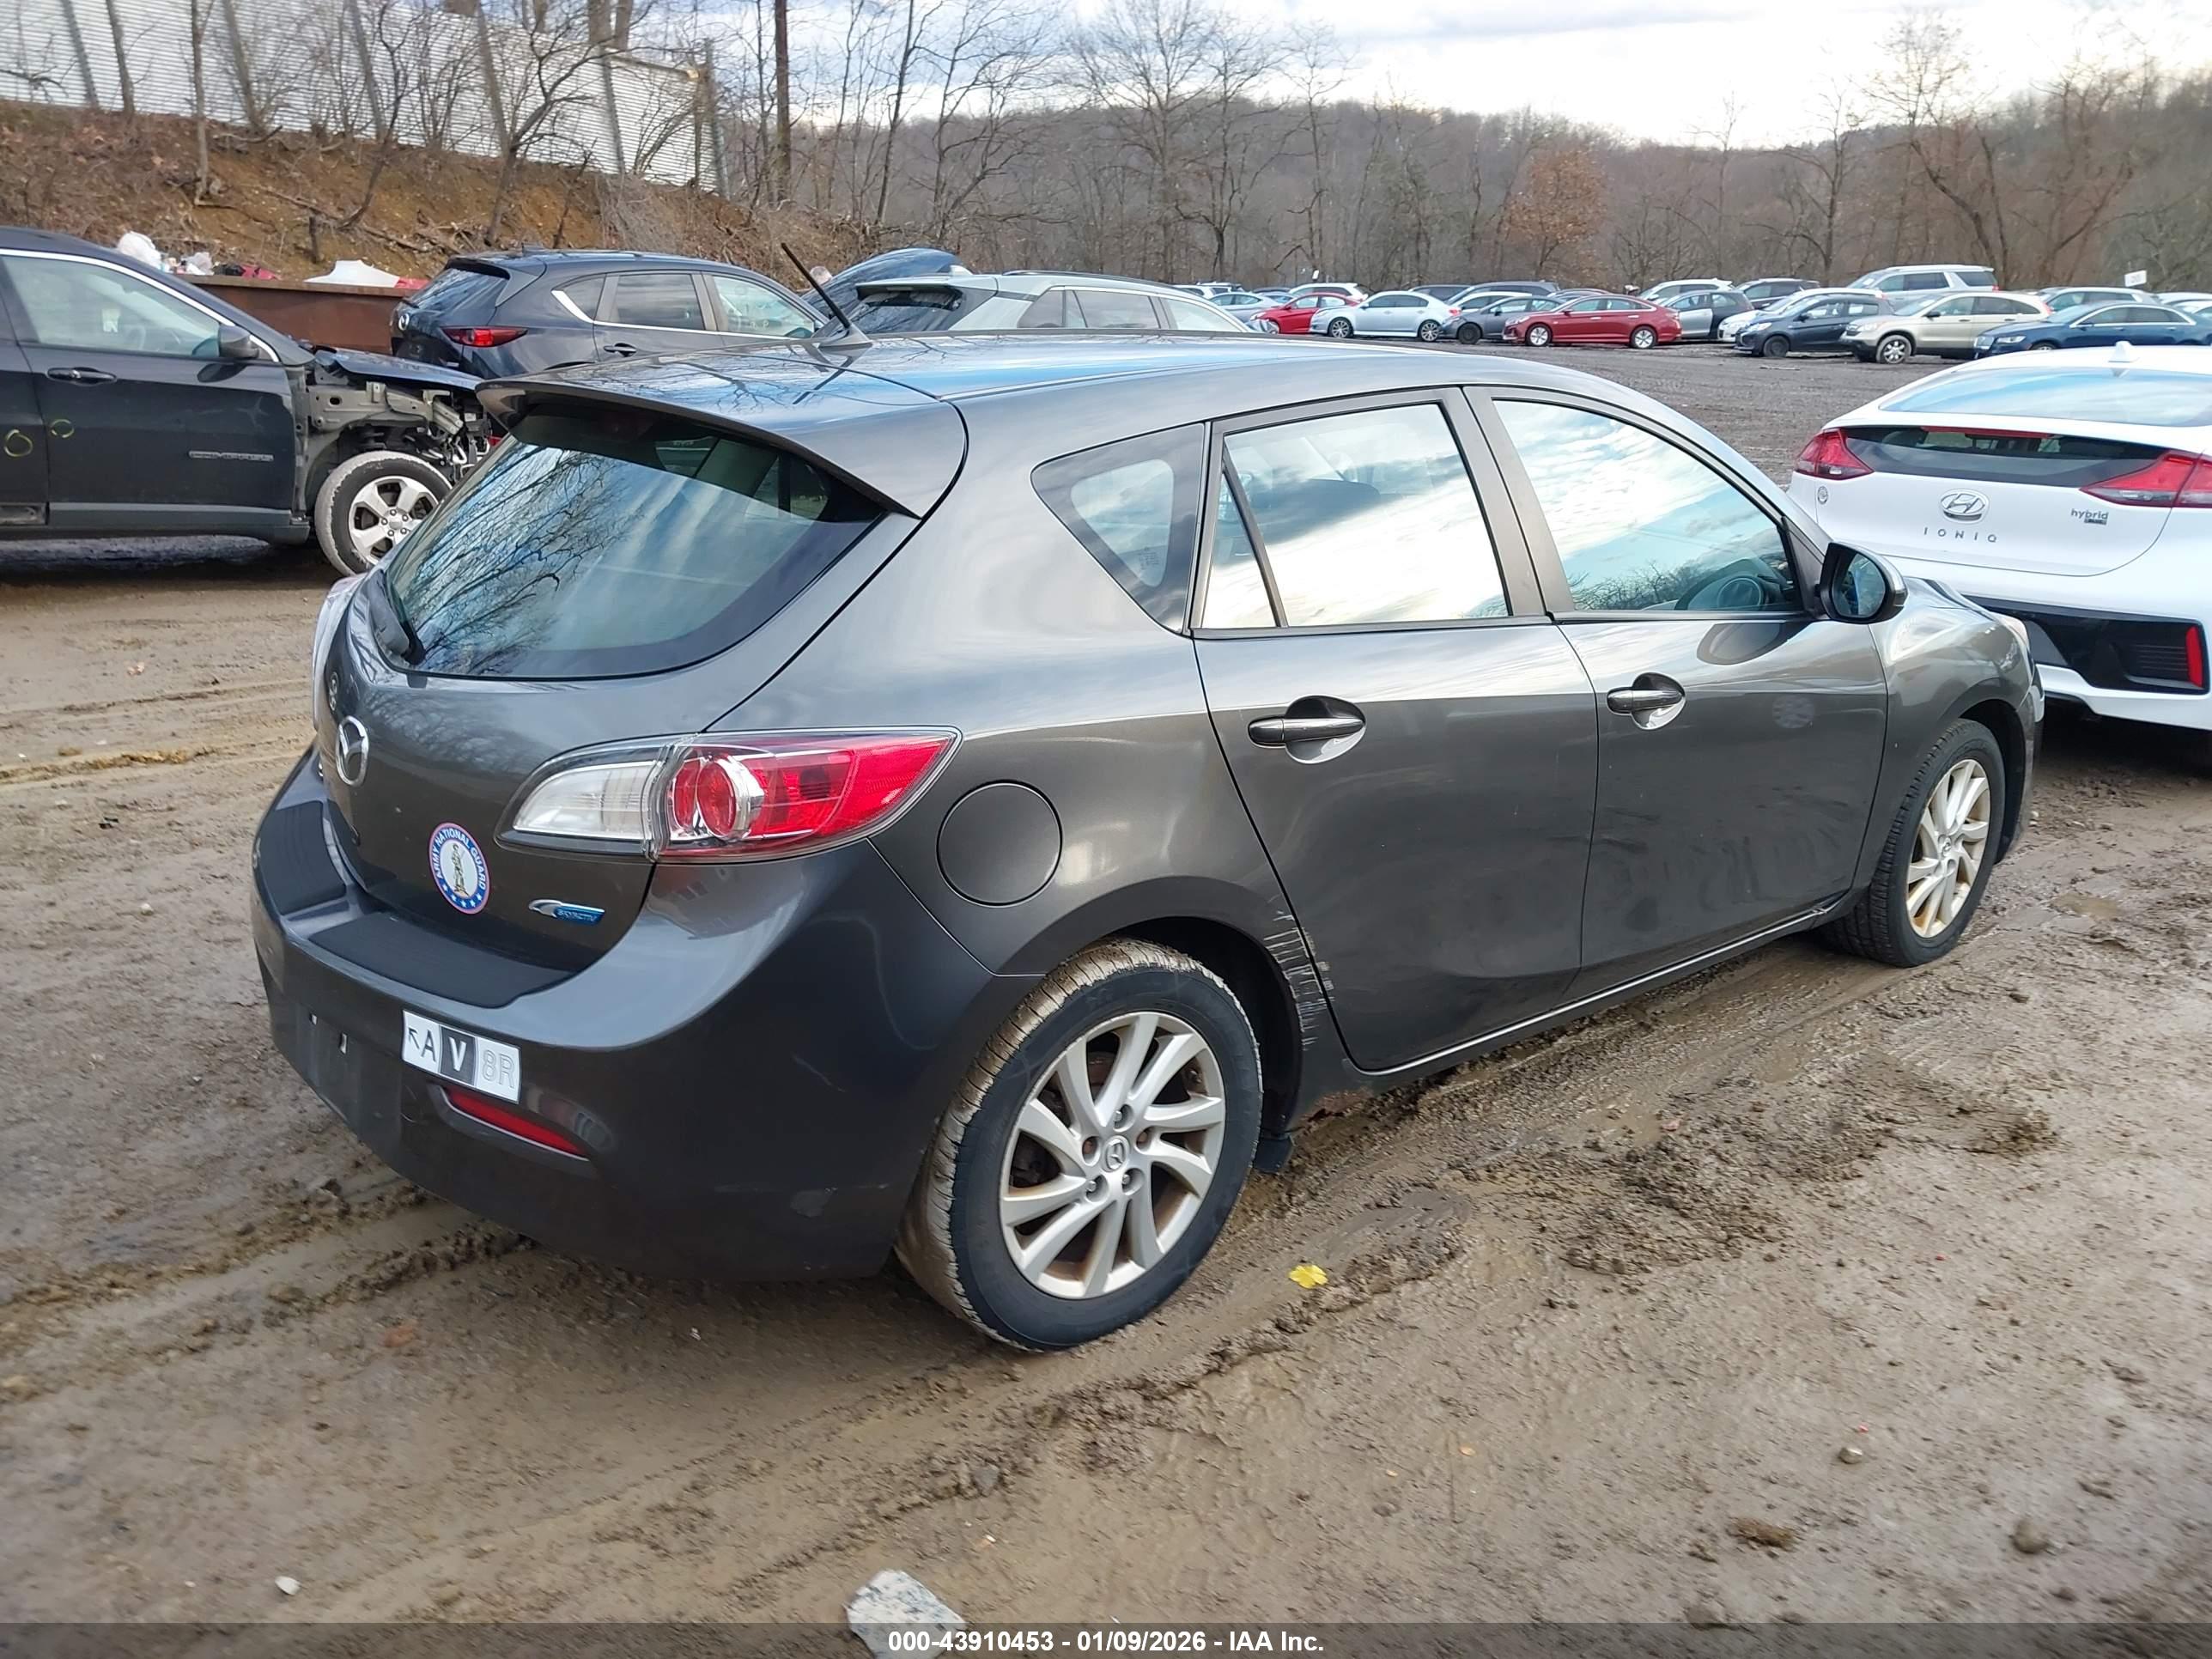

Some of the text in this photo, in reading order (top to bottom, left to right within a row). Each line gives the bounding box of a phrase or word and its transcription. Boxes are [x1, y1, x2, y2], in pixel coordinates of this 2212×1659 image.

[2070, 508, 2109, 520] hybrid
[1923, 526, 1997, 543] IONIQ
[432, 828, 487, 890] ARMY NATIONAL GUARD
